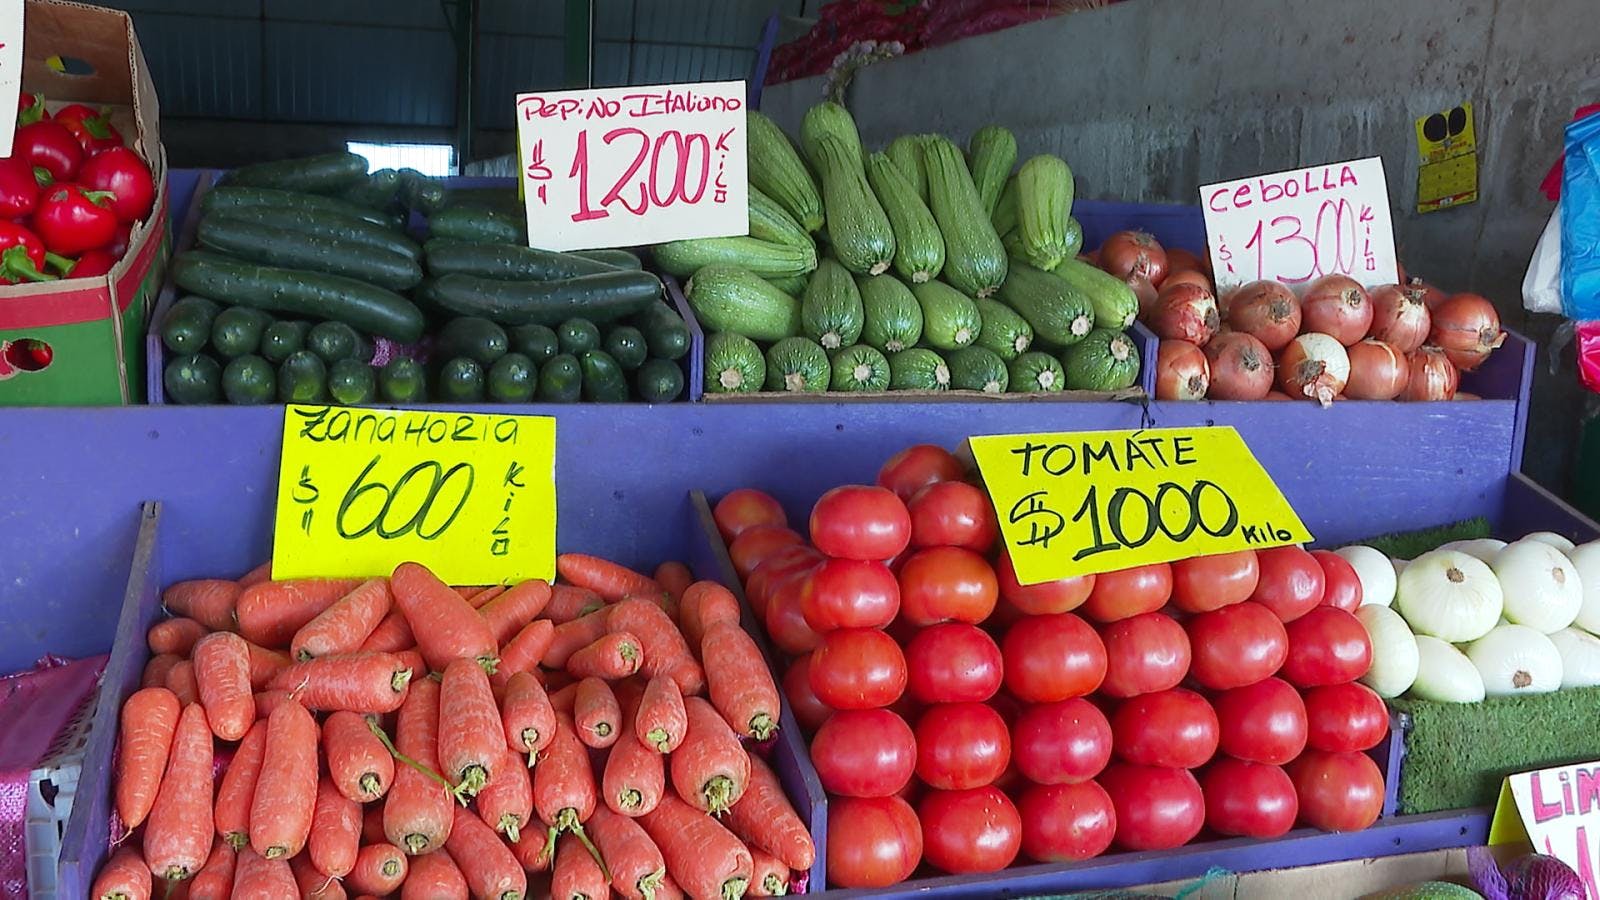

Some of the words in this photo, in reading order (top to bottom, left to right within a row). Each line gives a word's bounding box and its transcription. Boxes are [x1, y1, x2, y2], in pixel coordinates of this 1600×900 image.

[569, 127, 711, 222] 1200
[1245, 198, 1356, 284] 1300
[335, 454, 475, 541] 600
